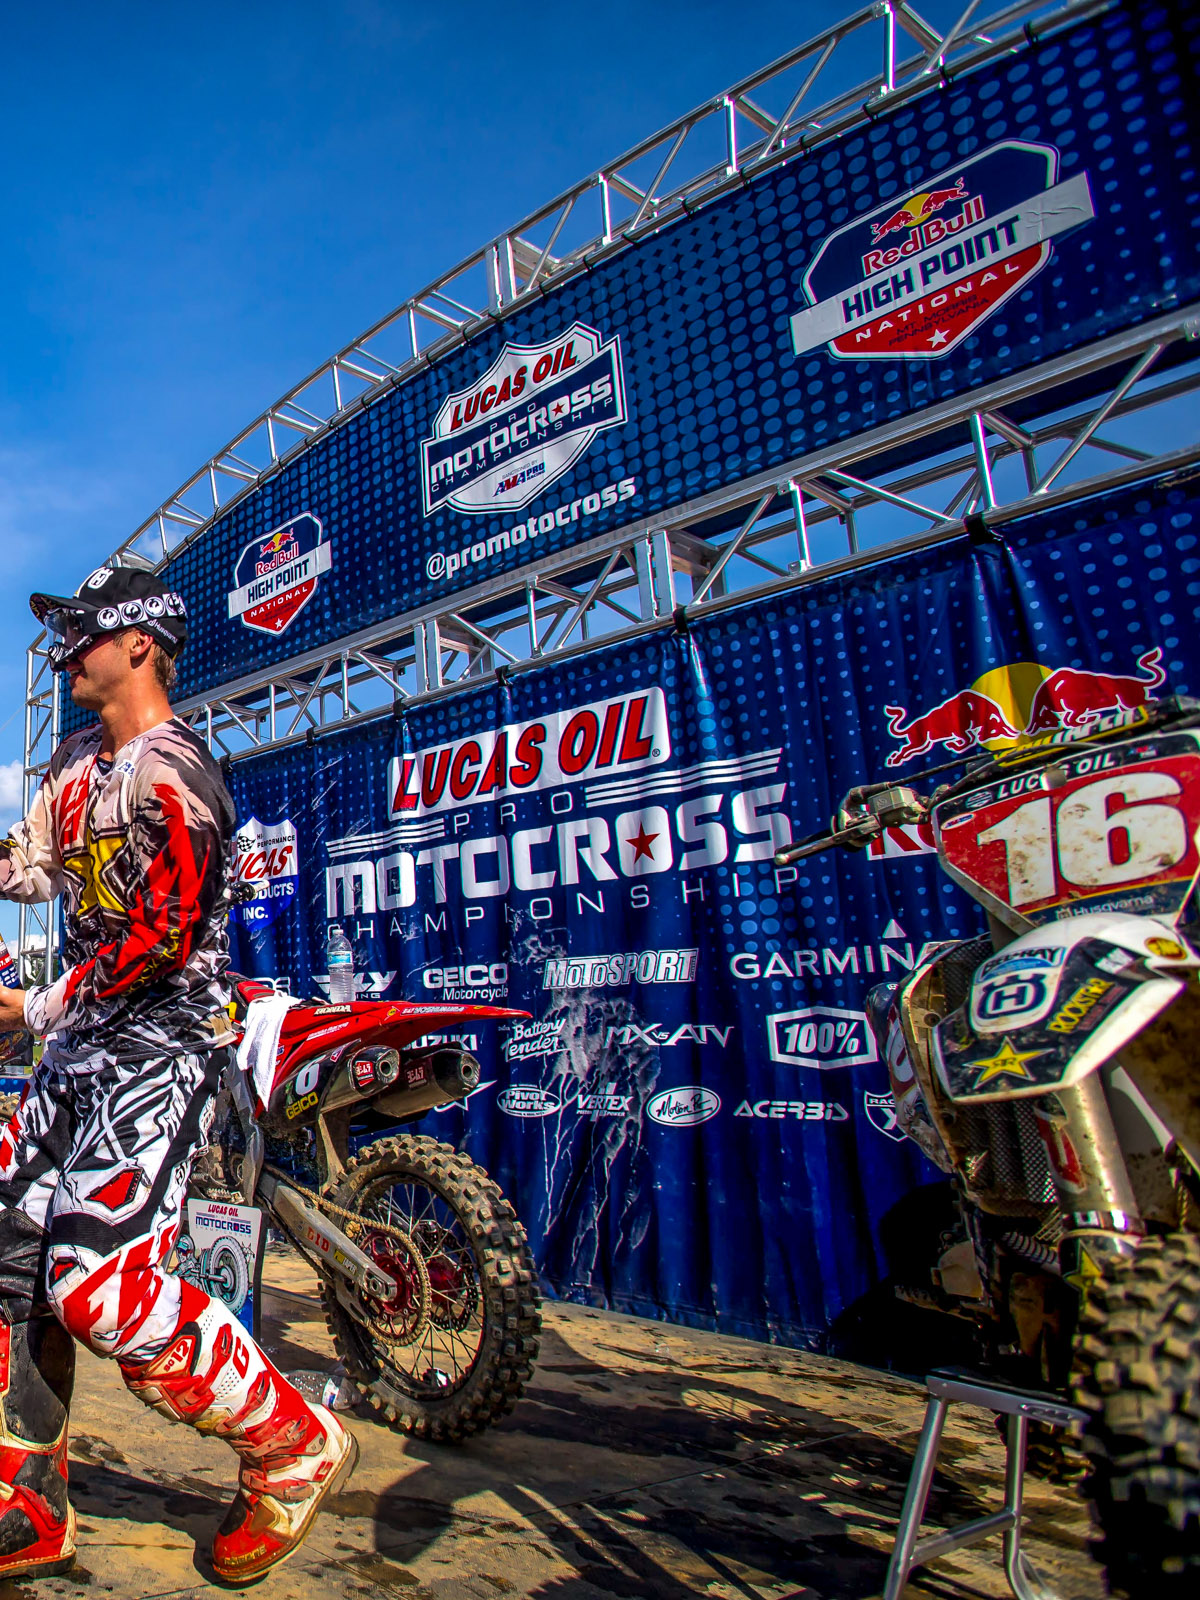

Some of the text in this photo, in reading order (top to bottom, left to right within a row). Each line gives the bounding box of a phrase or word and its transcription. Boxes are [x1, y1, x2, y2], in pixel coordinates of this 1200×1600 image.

[861, 195, 985, 278] Red Bull
[842, 214, 1021, 325] HIGH POINT
[855, 262, 1020, 343] NATIONAL
[888, 297, 989, 346] PENNSYLVANIA
[450, 340, 578, 432] LUCAS OIL
[430, 373, 612, 484] MOTOCROSS
[490, 402, 536, 432] PRO
[431, 396, 613, 493] CHAMPIONSHIP
[492, 470, 527, 497] AMA
[426, 477, 637, 580] @promotocross
[255, 541, 299, 576] Red Bull
[247, 558, 310, 604] HIGH POINT
[250, 586, 308, 618] NATIONAL
[392, 698, 654, 813] LUCAS OIL
[1076, 753, 1116, 775] OIL
[454, 792, 573, 834] PRO
[257, 834, 295, 848] PERFORMANCE
[325, 783, 794, 919] MOTOCROSS
[977, 772, 1188, 907] 16
[243, 906, 269, 920] INC.
[327, 866, 799, 941] CHAMPIONSHIP
[1074, 896, 1154, 916] Husqvarna
[423, 963, 509, 989] GEICO
[729, 943, 914, 979] GARMIN
[443, 986, 509, 1003] Motorcycle
[402, 1034, 478, 1051] UZUKI
[512, 1018, 566, 1041] Battery
[784, 1021, 860, 1054] 100%
[501, 1035, 559, 1062] Tender
[286, 1091, 319, 1120] GEICO
[502, 1099, 557, 1110] Works
[577, 1094, 635, 1111] VERTEX
[656, 1094, 692, 1117] Motion
[733, 1100, 850, 1120] ACERBIS
[196, 1216, 252, 1234] MOTOCROSS
[208, 1204, 239, 1217] LUCAS OIL
[171, 1339, 190, 1363] 12
